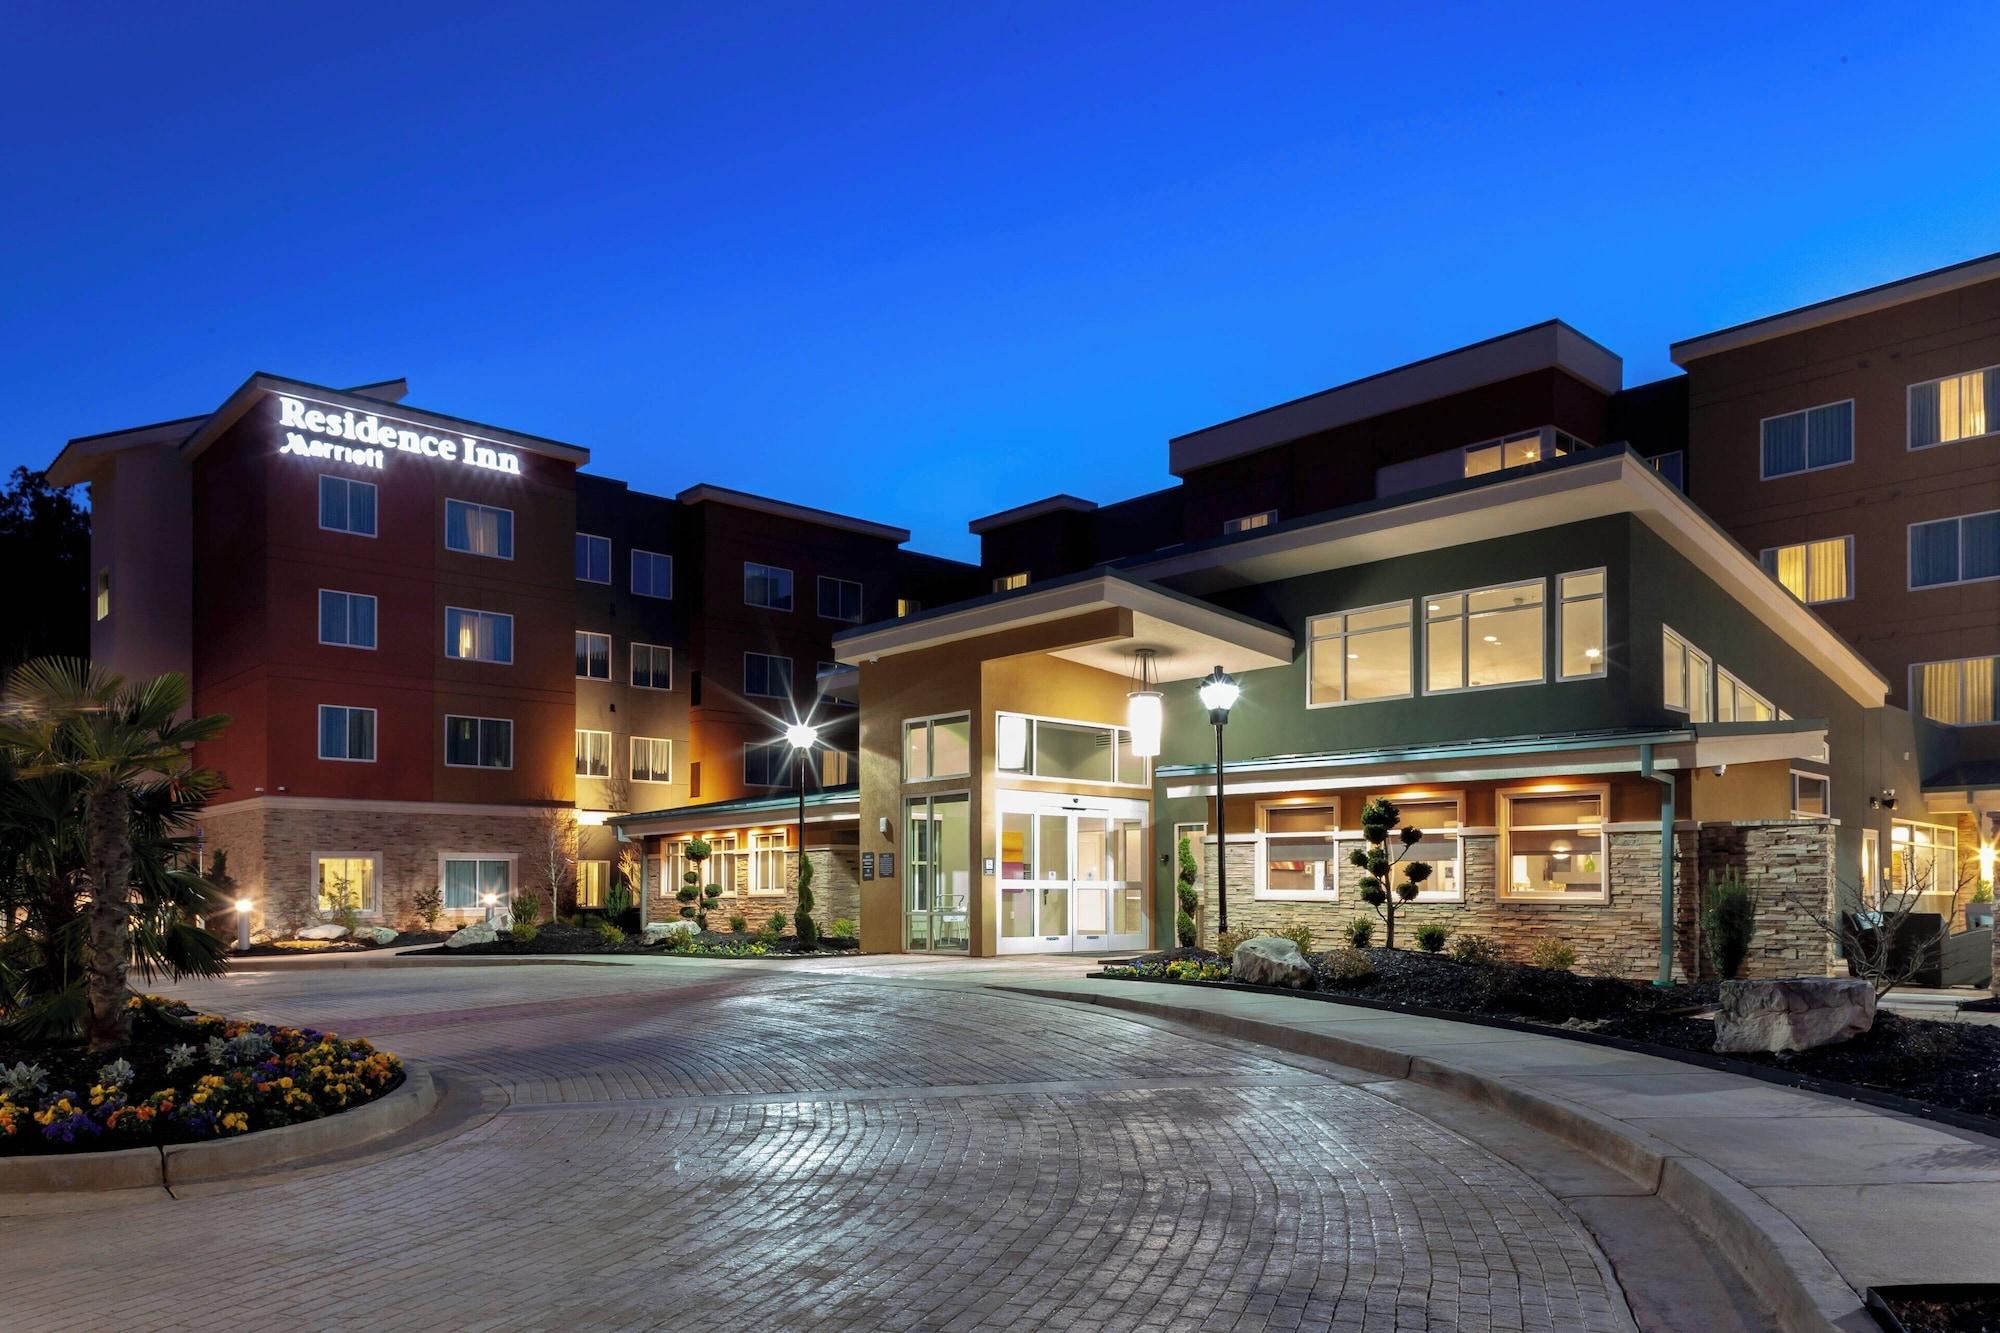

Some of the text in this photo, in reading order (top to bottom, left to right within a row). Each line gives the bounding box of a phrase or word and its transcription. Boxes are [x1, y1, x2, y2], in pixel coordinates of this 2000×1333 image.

[279, 396, 521, 475] Residence Inn
[279, 432, 385, 470] Marriott
